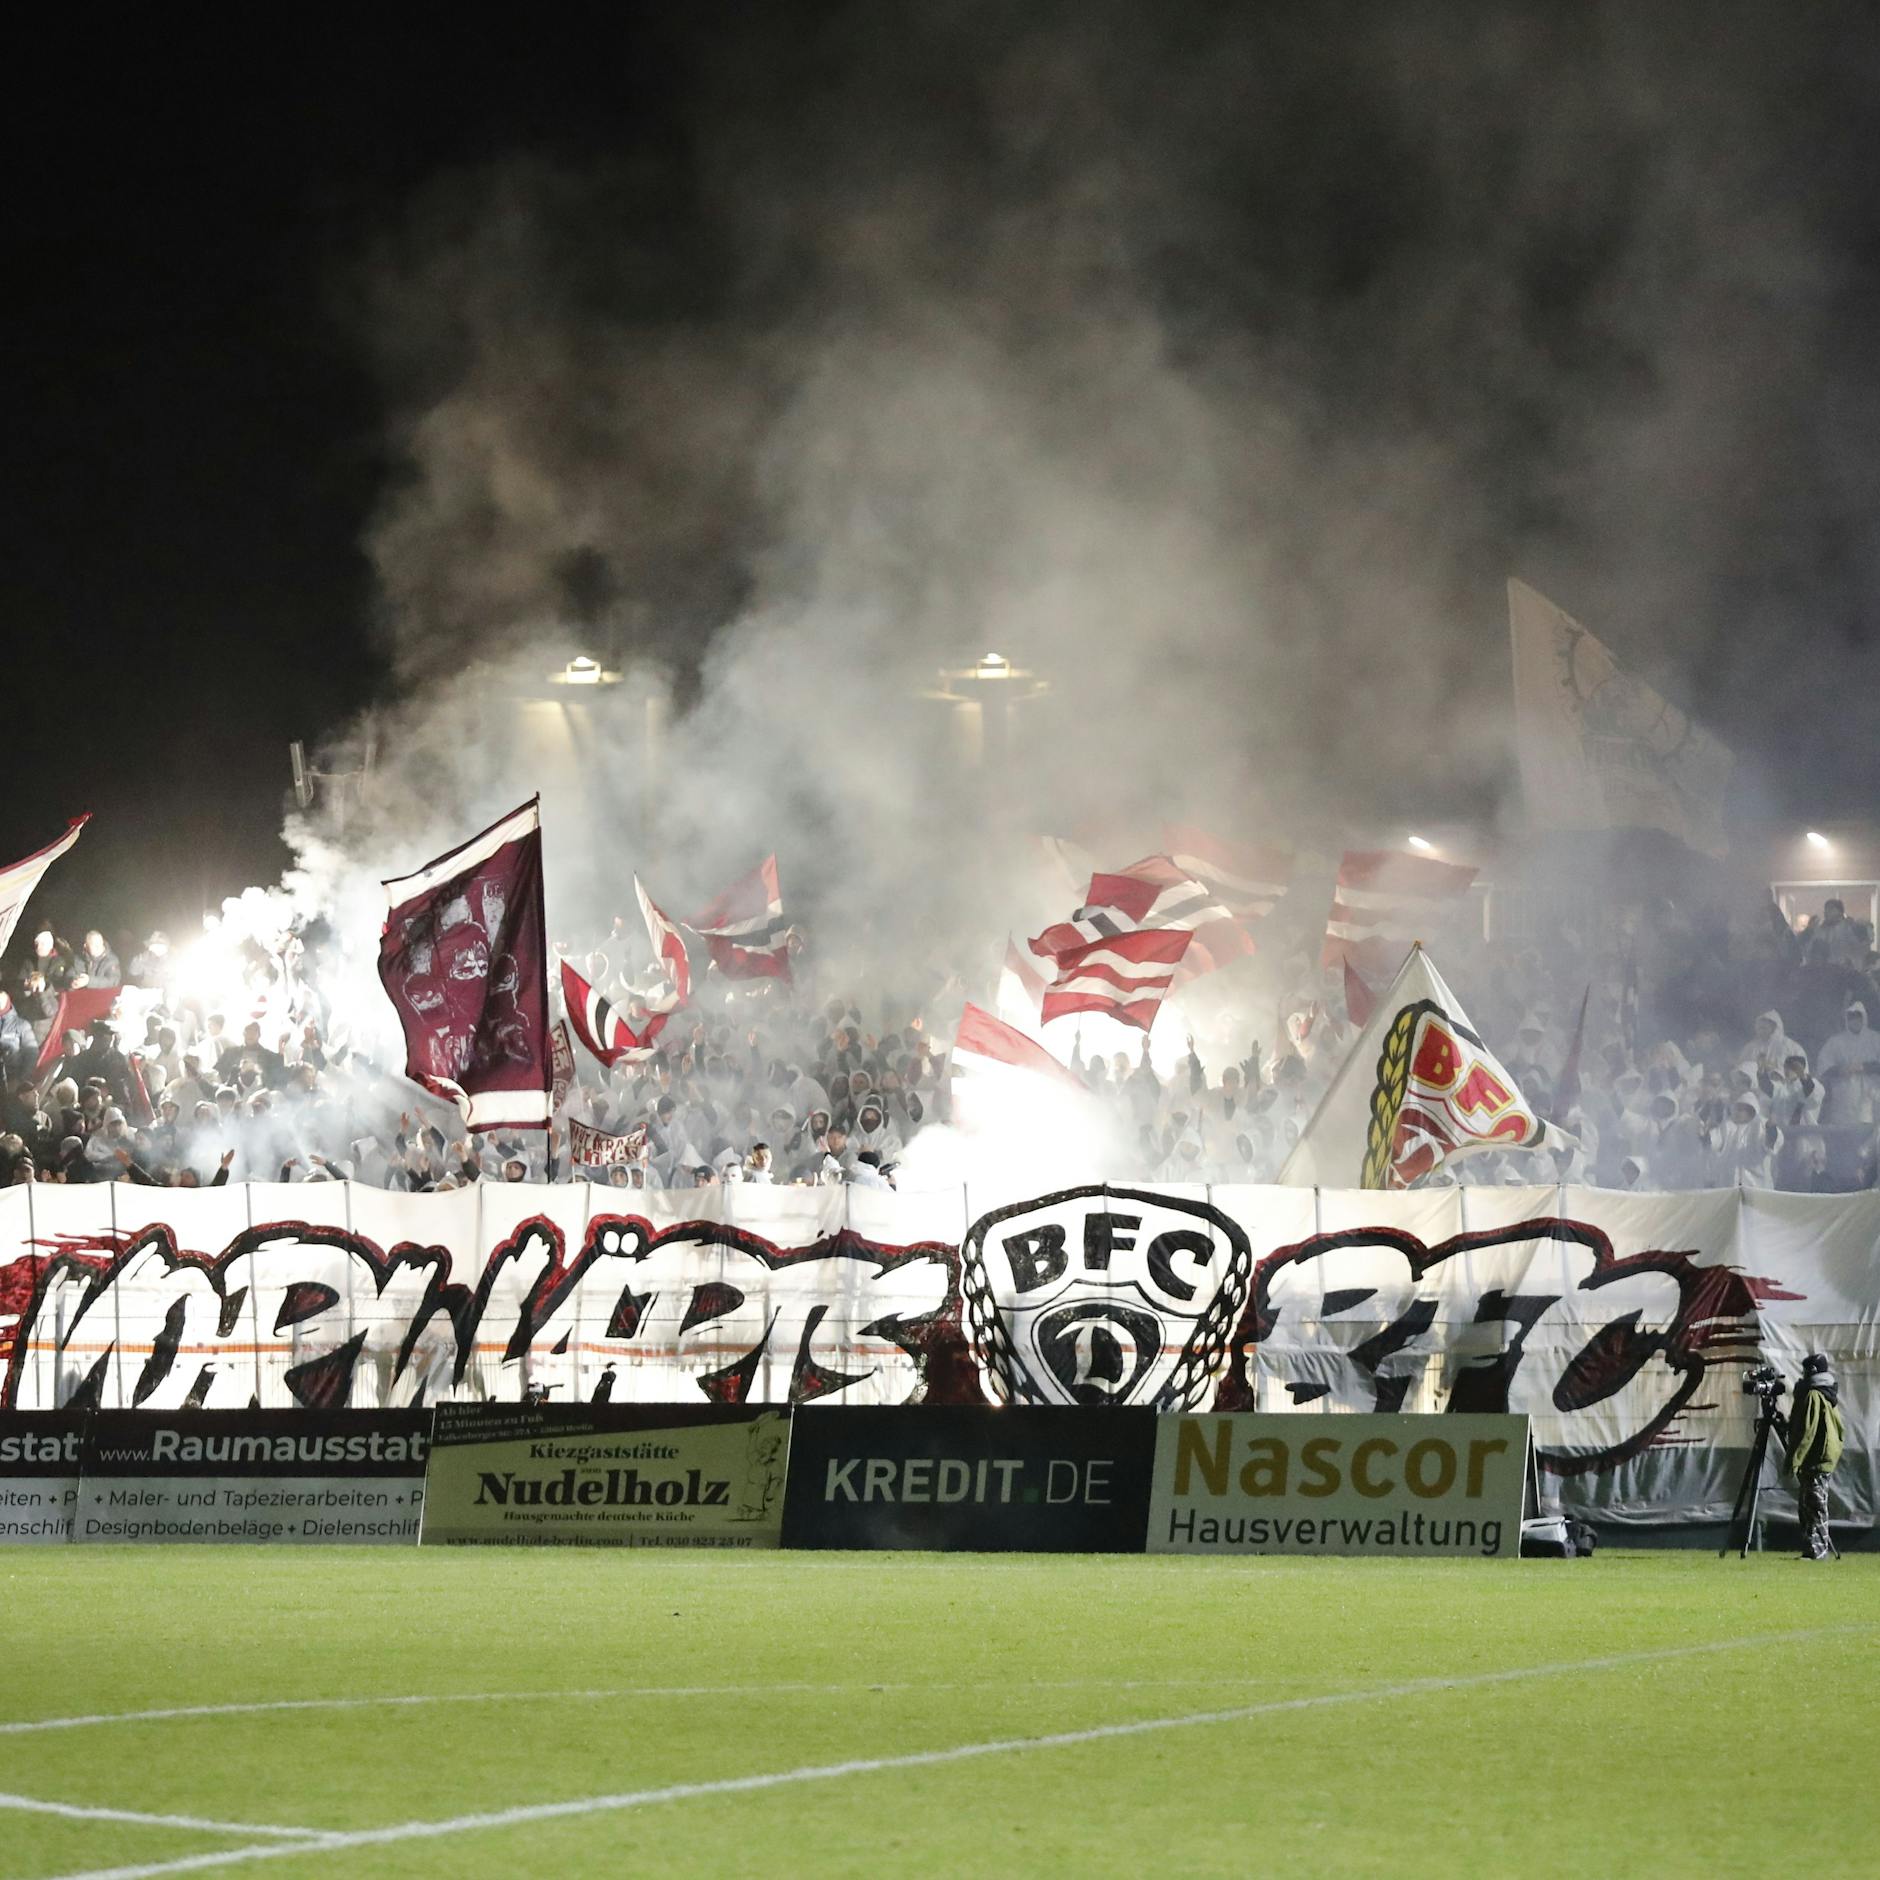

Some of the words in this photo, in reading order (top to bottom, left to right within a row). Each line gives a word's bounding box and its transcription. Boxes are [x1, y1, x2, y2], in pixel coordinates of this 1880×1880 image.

[1001, 1213, 1215, 1301] BFC
[0, 1431, 84, 1462] stat
[99, 1429, 430, 1463] www.Raumausstat
[530, 1442, 679, 1464] Kiezgaststätte
[1173, 1418, 1508, 1499] Nascor
[473, 1468, 730, 1506] Nudelholz
[824, 1458, 1115, 1504] KREDIT.DE
[109, 1489, 169, 1506] Maler-
[177, 1489, 215, 1506] und
[223, 1489, 388, 1510] Tapezierarbeiten
[503, 1511, 596, 1522] Hausgemachte
[597, 1510, 653, 1521] deutsche
[655, 1510, 695, 1521] Küche
[86, 1518, 283, 1539] Designbodenbeläge
[1169, 1507, 1503, 1556] Hausverwaltung
